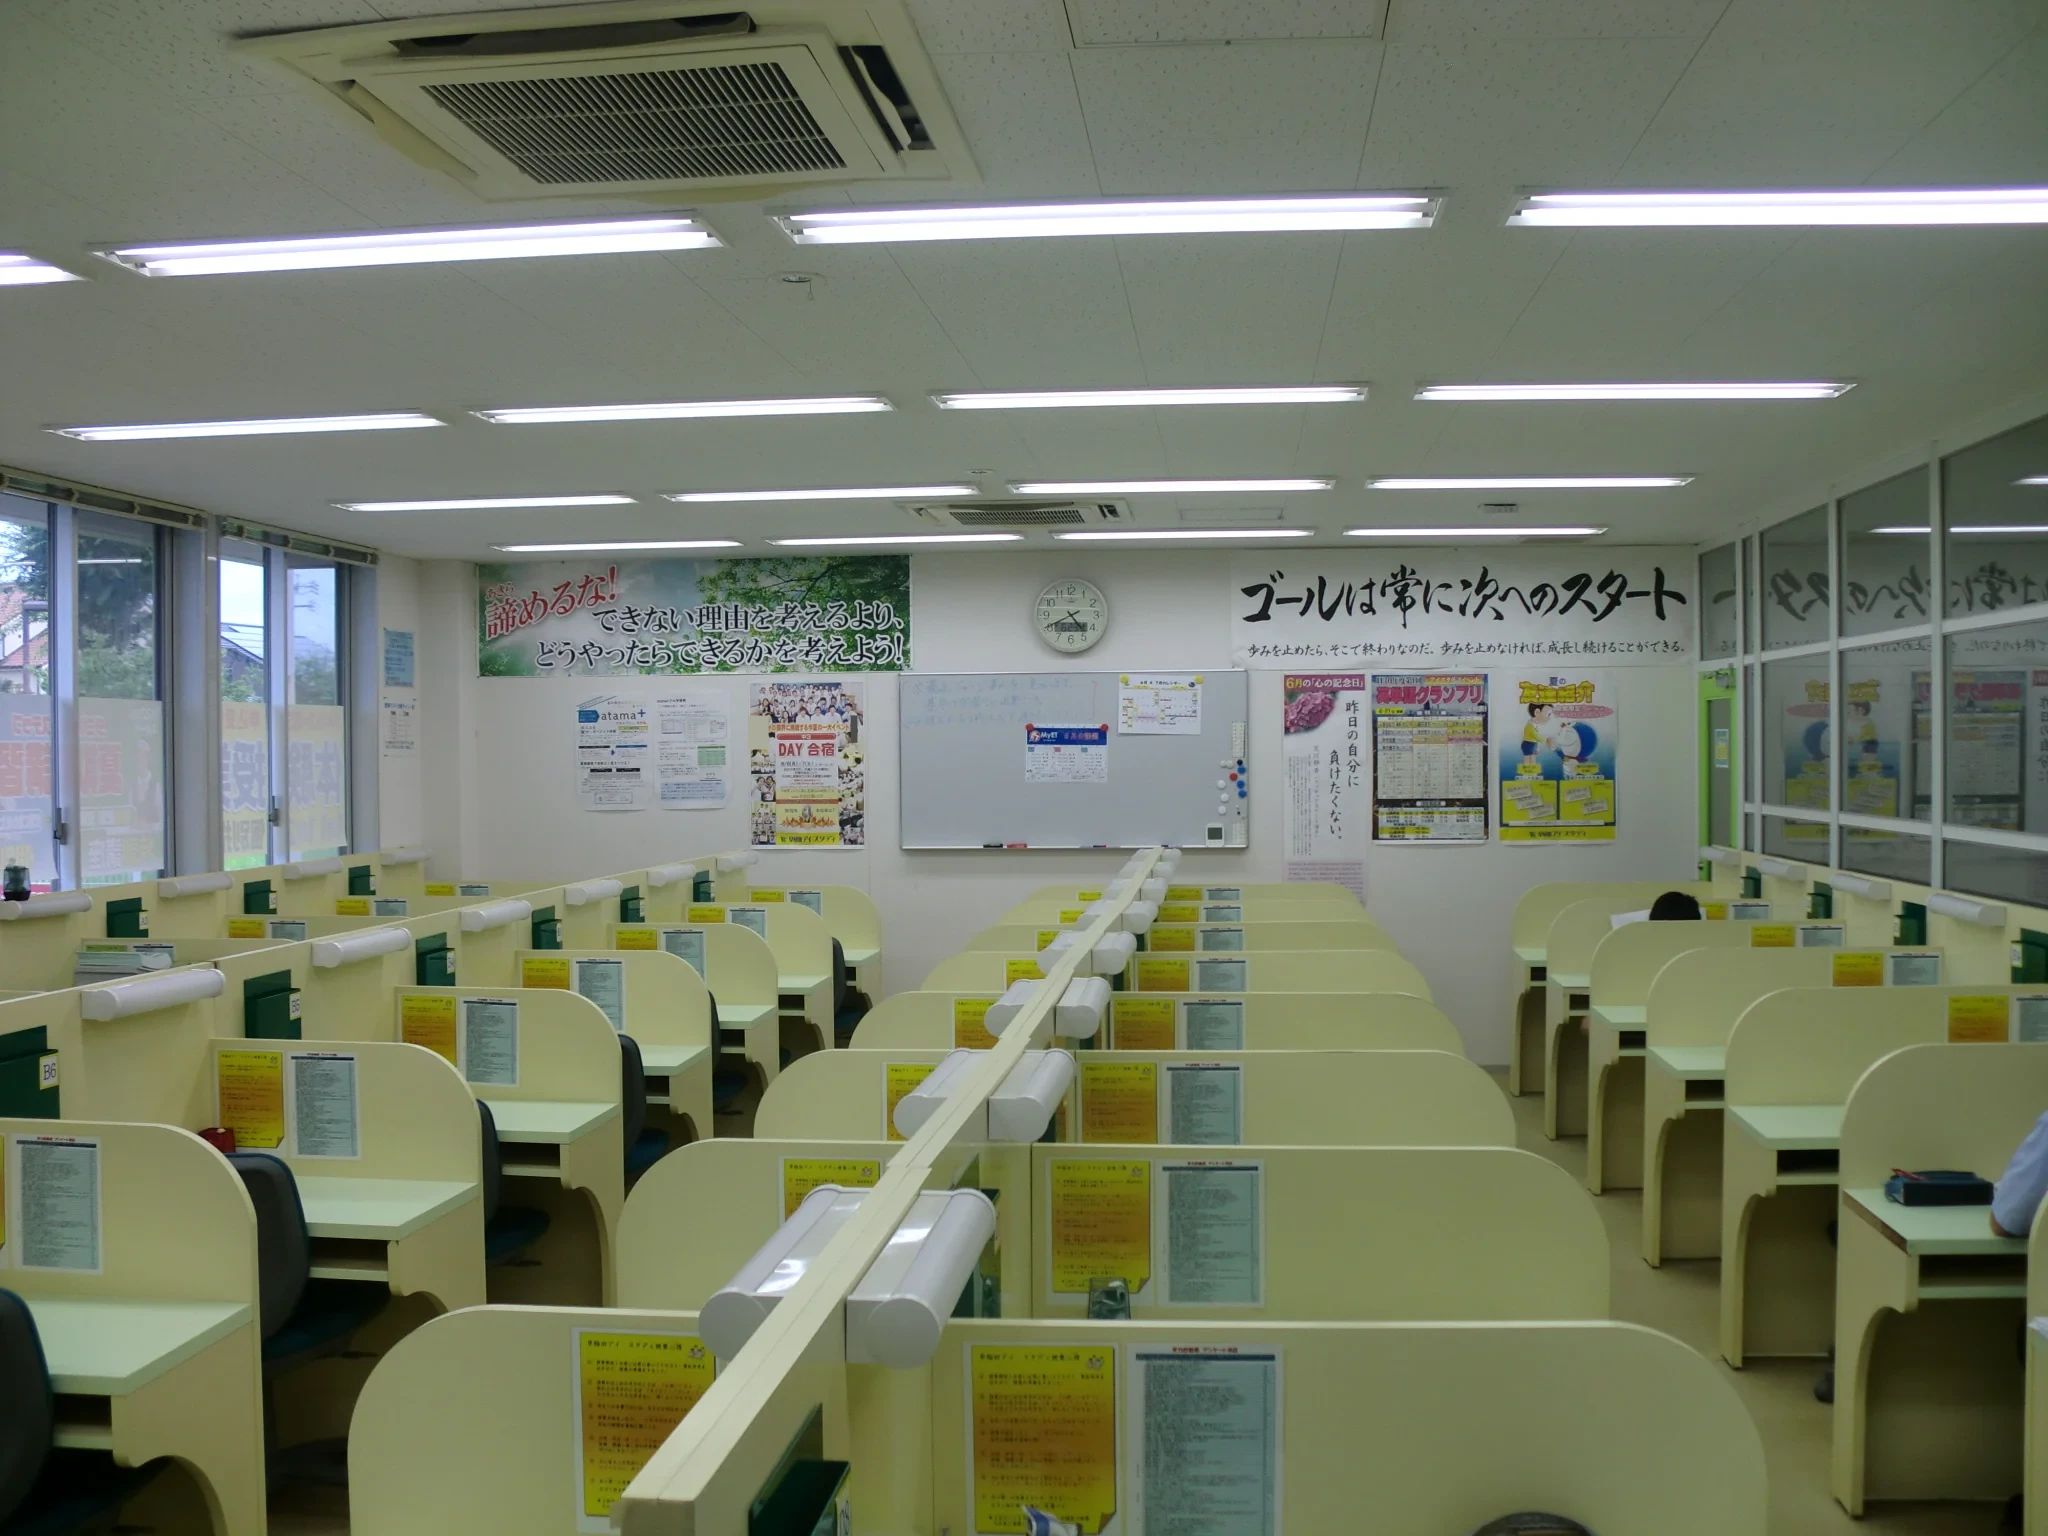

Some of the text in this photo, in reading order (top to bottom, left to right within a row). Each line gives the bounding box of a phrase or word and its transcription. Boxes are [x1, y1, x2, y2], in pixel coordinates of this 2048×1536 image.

[592, 601, 905, 634] できない理由を考えるより、
[1240, 563, 1688, 629] ゴールは常に次へのスタート
[779, 742, 835, 757] DAY 合宿
[1345, 700, 1361, 788] 昨日の自分に
[1329, 749, 1342, 840] 負けたくない。
[43, 1062, 56, 1080] B6
